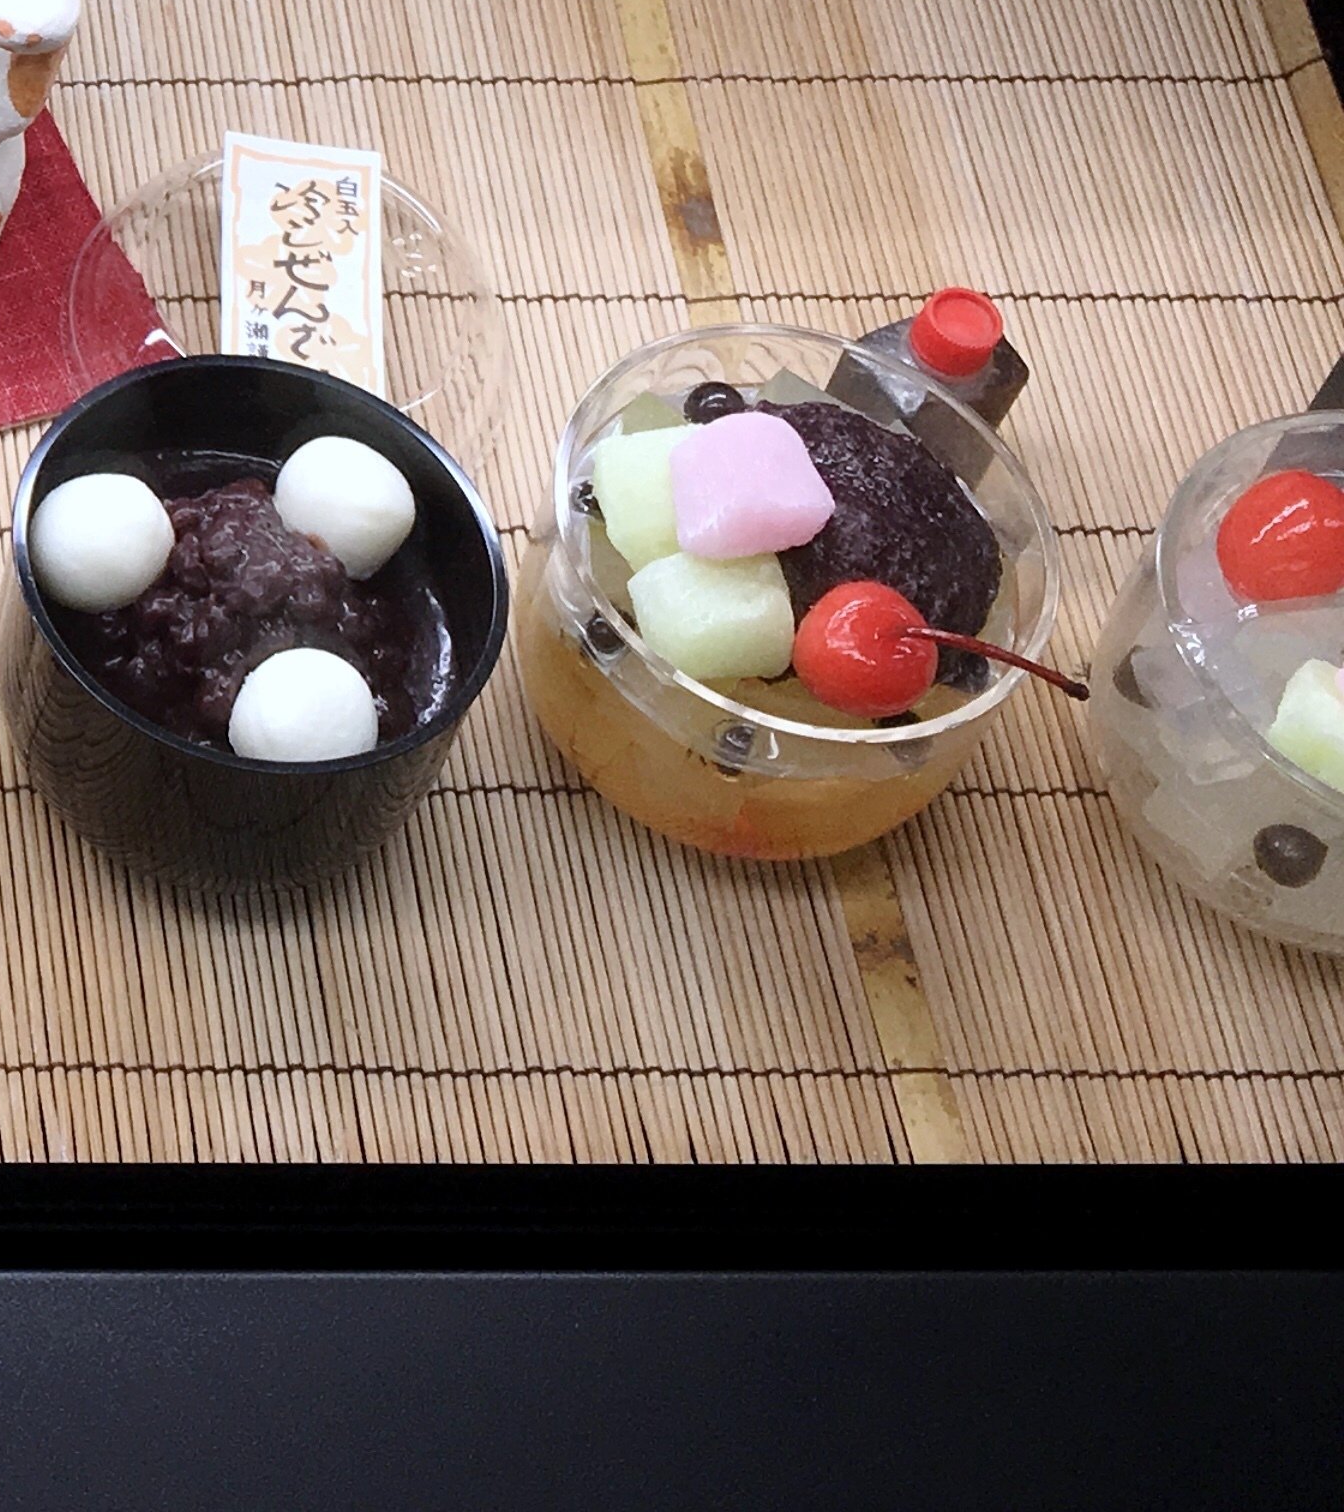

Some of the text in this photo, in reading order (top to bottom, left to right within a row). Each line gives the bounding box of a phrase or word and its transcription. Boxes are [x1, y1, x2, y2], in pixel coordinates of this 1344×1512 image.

[335, 176, 359, 236] 白玉入
[271, 181, 336, 374] 冷しぜんざ
